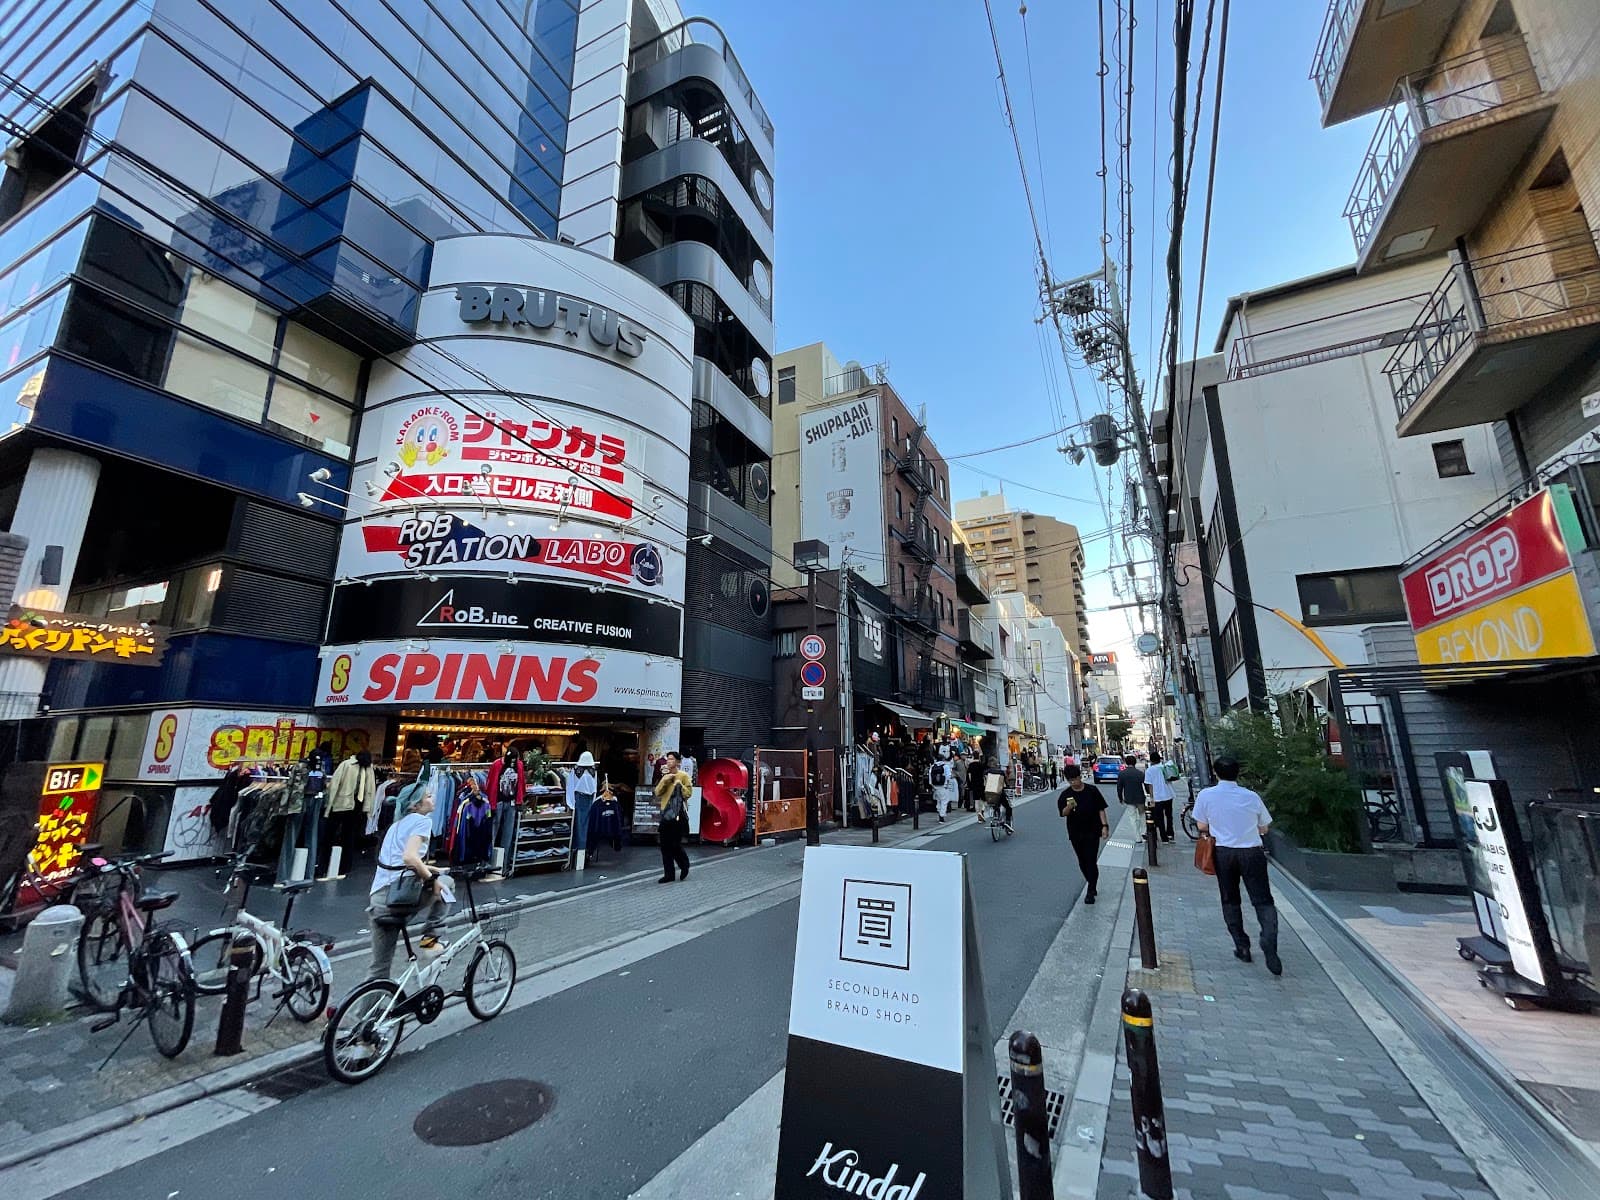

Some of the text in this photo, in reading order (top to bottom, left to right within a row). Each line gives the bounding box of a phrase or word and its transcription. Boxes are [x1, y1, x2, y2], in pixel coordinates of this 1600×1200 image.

[455, 286, 647, 358] BRUTUS
[462, 411, 626, 465] ジャンカラ
[805, 401, 869, 445] SHUPAAAN
[404, 534, 626, 569] STATION LABO
[1427, 530, 1517, 612] DROP
[51, 619, 154, 637] ハンバーグレストラン
[439, 606, 633, 639] RoB.inc CREATIVE FUSION
[806, 642, 820, 653] 30
[362, 653, 601, 703] SPINNS
[828, 978, 920, 1005] SECONDHAND
[827, 1000, 919, 1028] BRAND SHOP.
